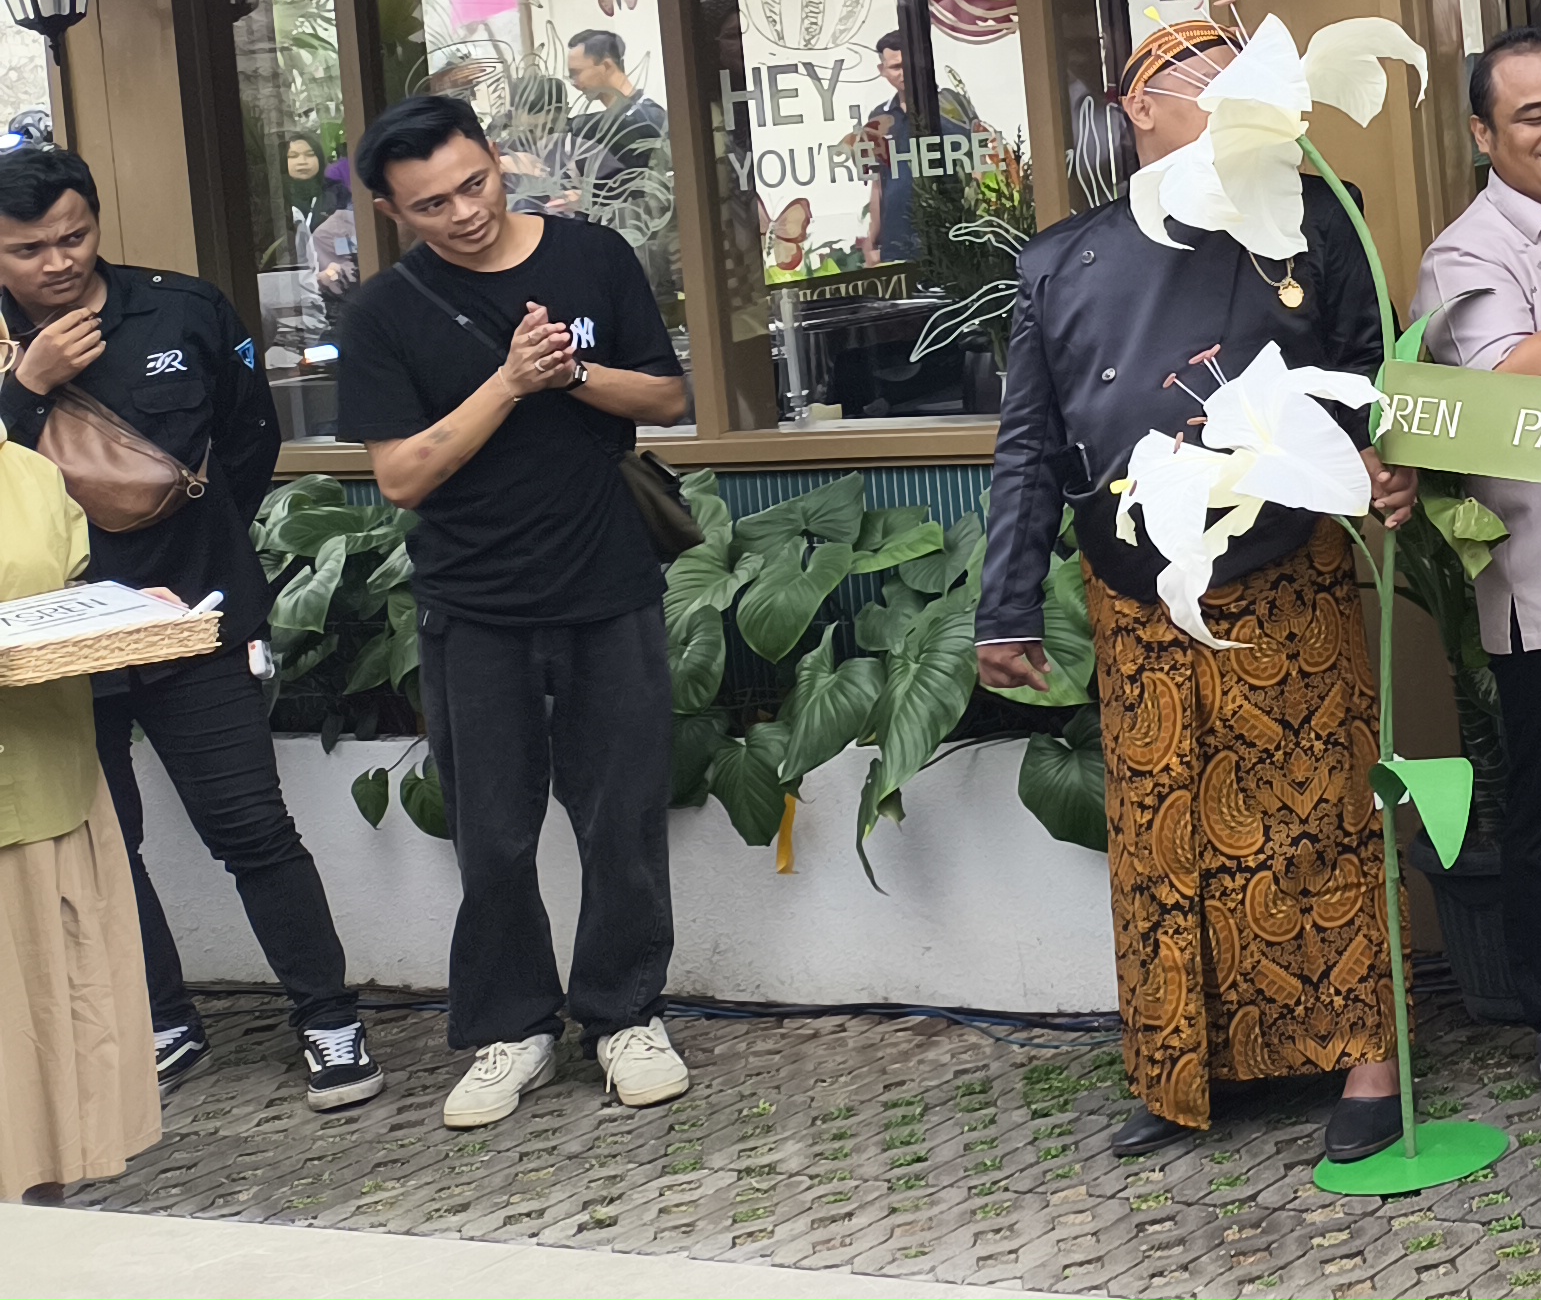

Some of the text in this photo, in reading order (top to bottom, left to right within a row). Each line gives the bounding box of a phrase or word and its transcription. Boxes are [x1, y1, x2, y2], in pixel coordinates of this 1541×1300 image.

[719, 59, 863, 132] HEY,
[727, 130, 1007, 191] YOU'RE HERE!
[1388, 394, 1463, 438] REN
